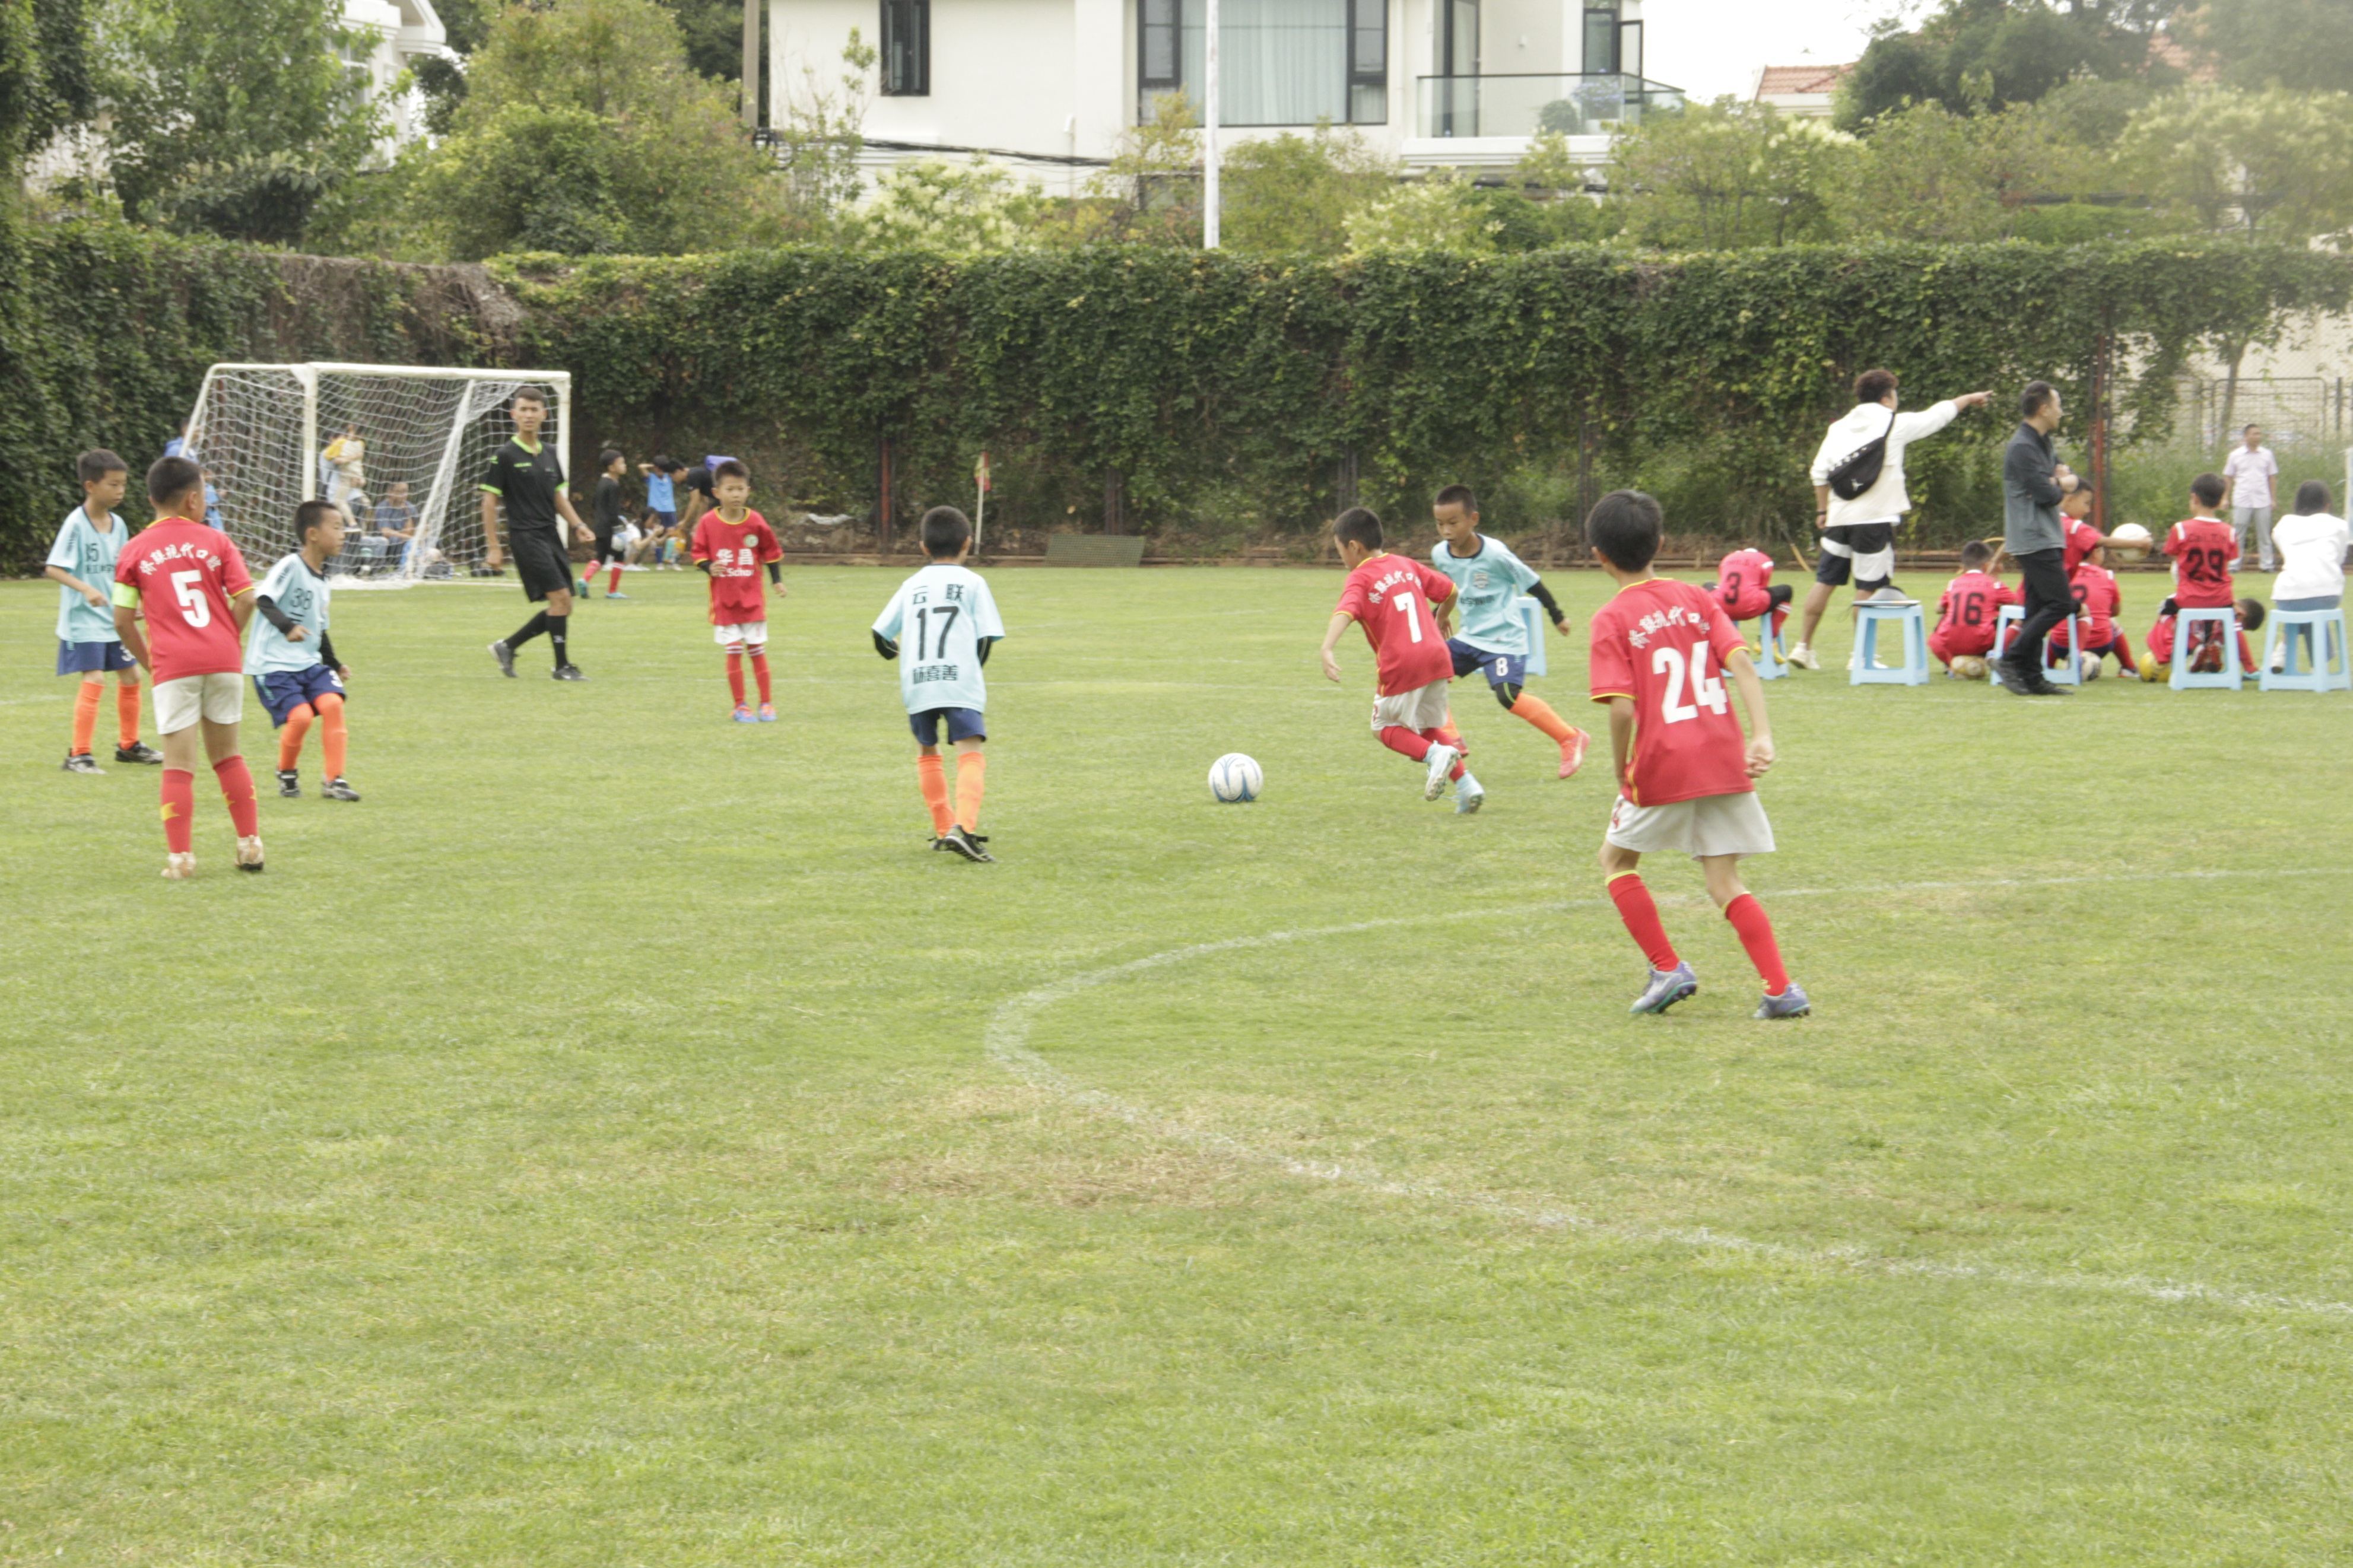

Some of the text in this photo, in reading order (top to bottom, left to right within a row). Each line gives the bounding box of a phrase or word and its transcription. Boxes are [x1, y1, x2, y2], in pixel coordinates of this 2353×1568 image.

[2187, 548, 2224, 582] 29
[170, 570, 211, 628] 5
[913, 584, 965, 605] 云联
[1725, 572, 1741, 605] 3
[1393, 591, 1423, 643] 7
[1951, 592, 1986, 626] 16
[916, 606, 959, 661] 17
[1495, 656, 1509, 677] 8
[1652, 640, 1728, 724] 24
